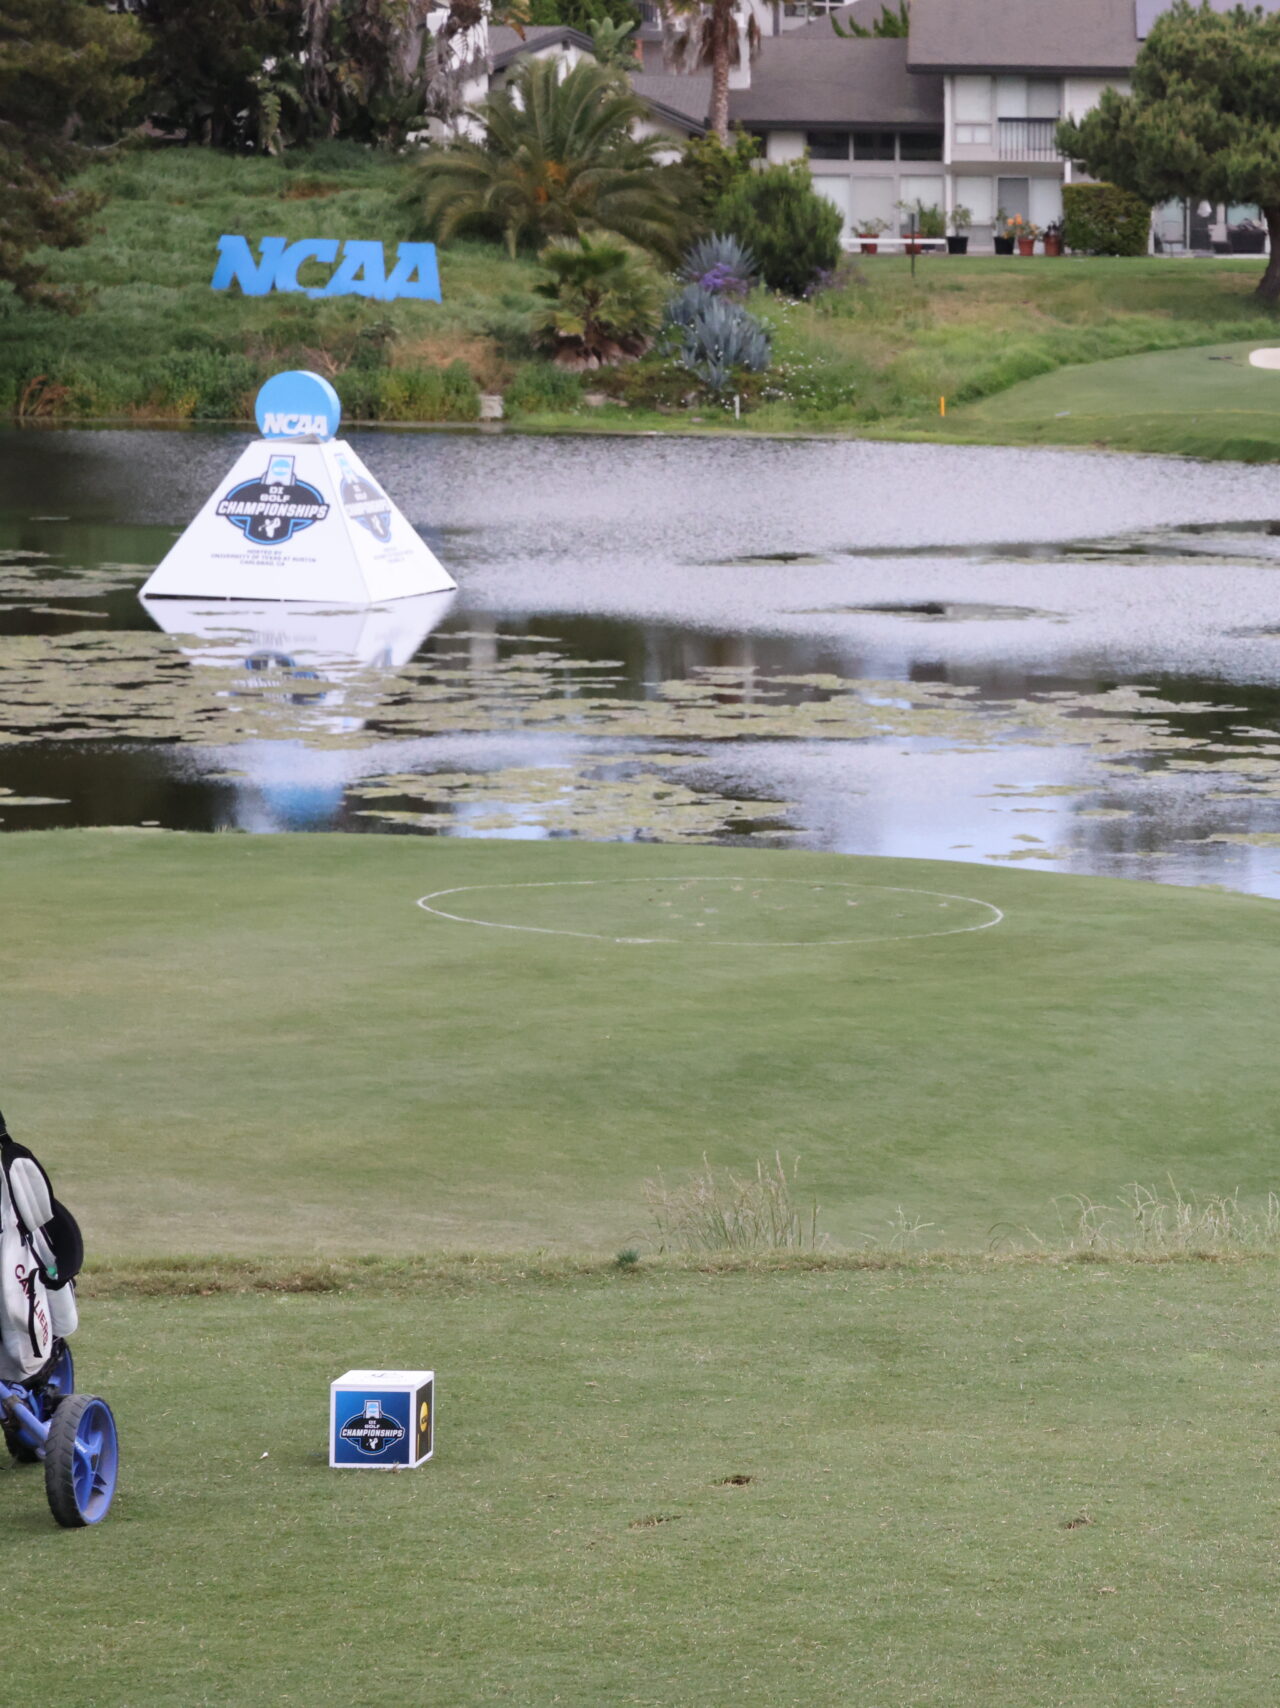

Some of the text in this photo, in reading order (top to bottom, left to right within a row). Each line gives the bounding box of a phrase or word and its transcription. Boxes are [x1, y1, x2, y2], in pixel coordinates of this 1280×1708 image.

[210, 234, 443, 304] NCAA
[262, 413, 329, 437] NCAA
[259, 493, 291, 503] GOLF
[268, 486, 284, 495] DI
[217, 500, 328, 519] CHAMPIONSHIPS
[15, 1263, 50, 1347] CAVLIERS
[341, 1428, 404, 1437] CHAMPIONSHIPS
